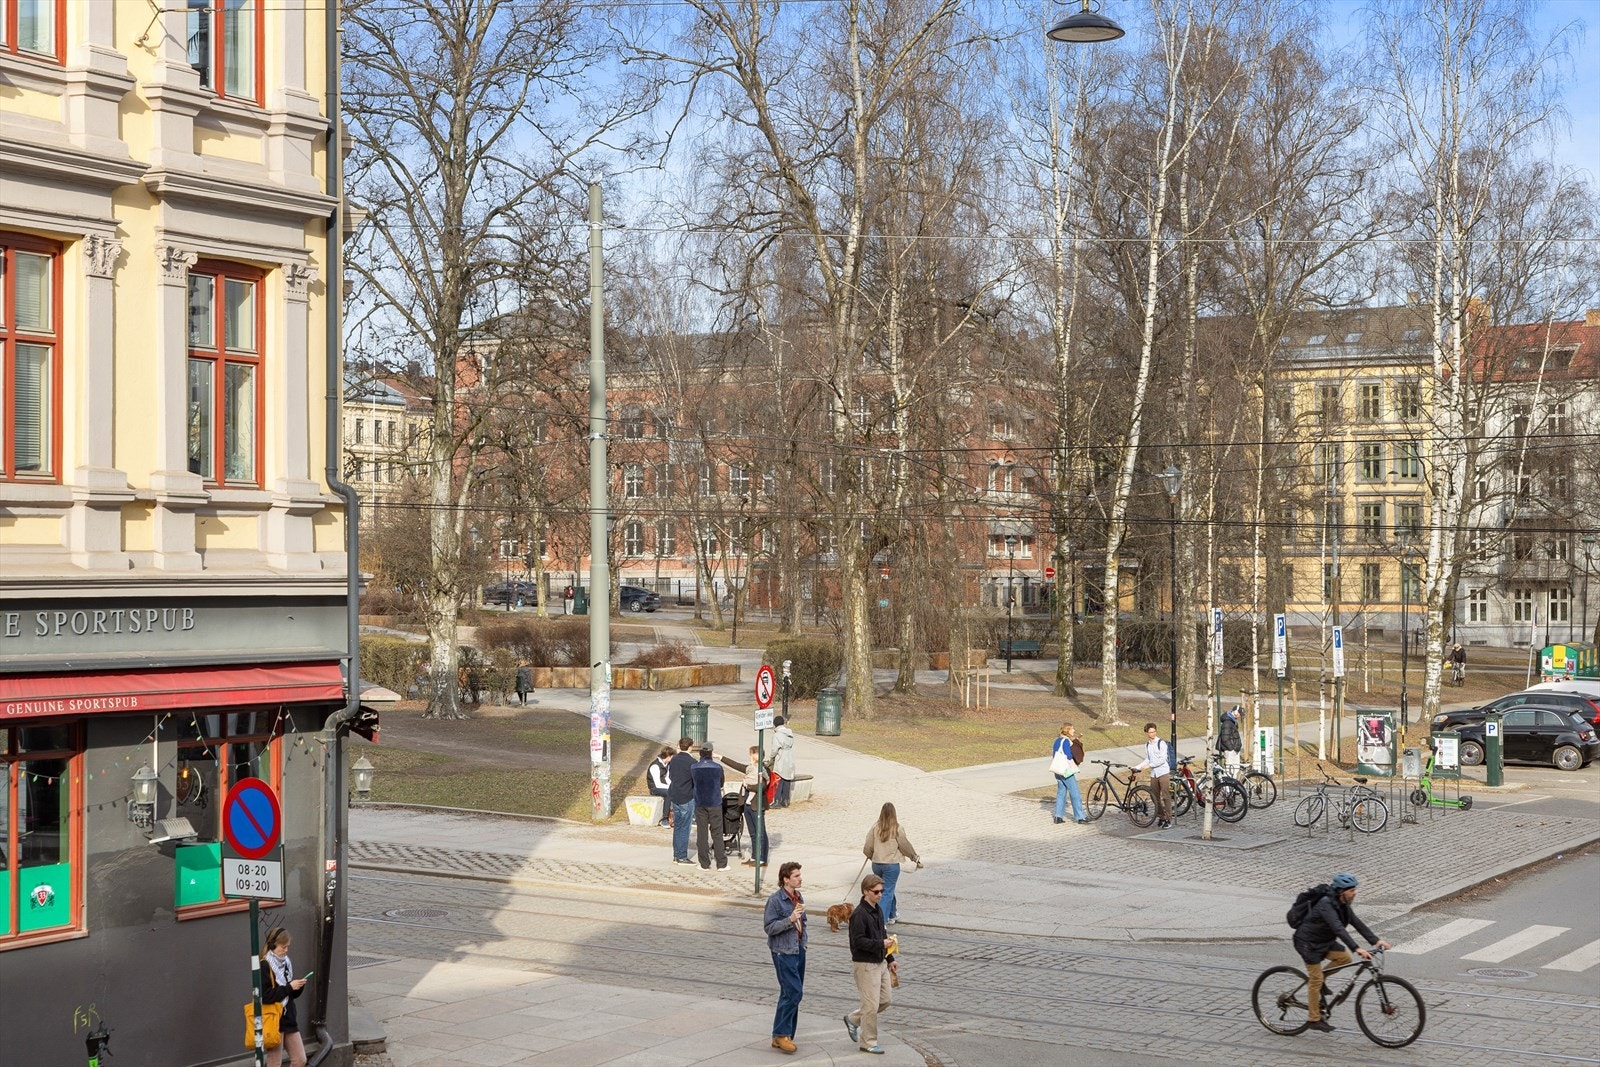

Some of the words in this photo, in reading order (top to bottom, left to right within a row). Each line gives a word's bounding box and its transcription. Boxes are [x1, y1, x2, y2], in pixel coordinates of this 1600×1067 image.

[35, 608, 195, 637] SPORTSPUB
[6, 700, 65, 715] GENUINE
[69, 697, 138, 711] SPORTSPUB
[1488, 724, 1496, 734] P
[237, 863, 267, 877] 08-20
[235, 878, 270, 893] (09-20)
